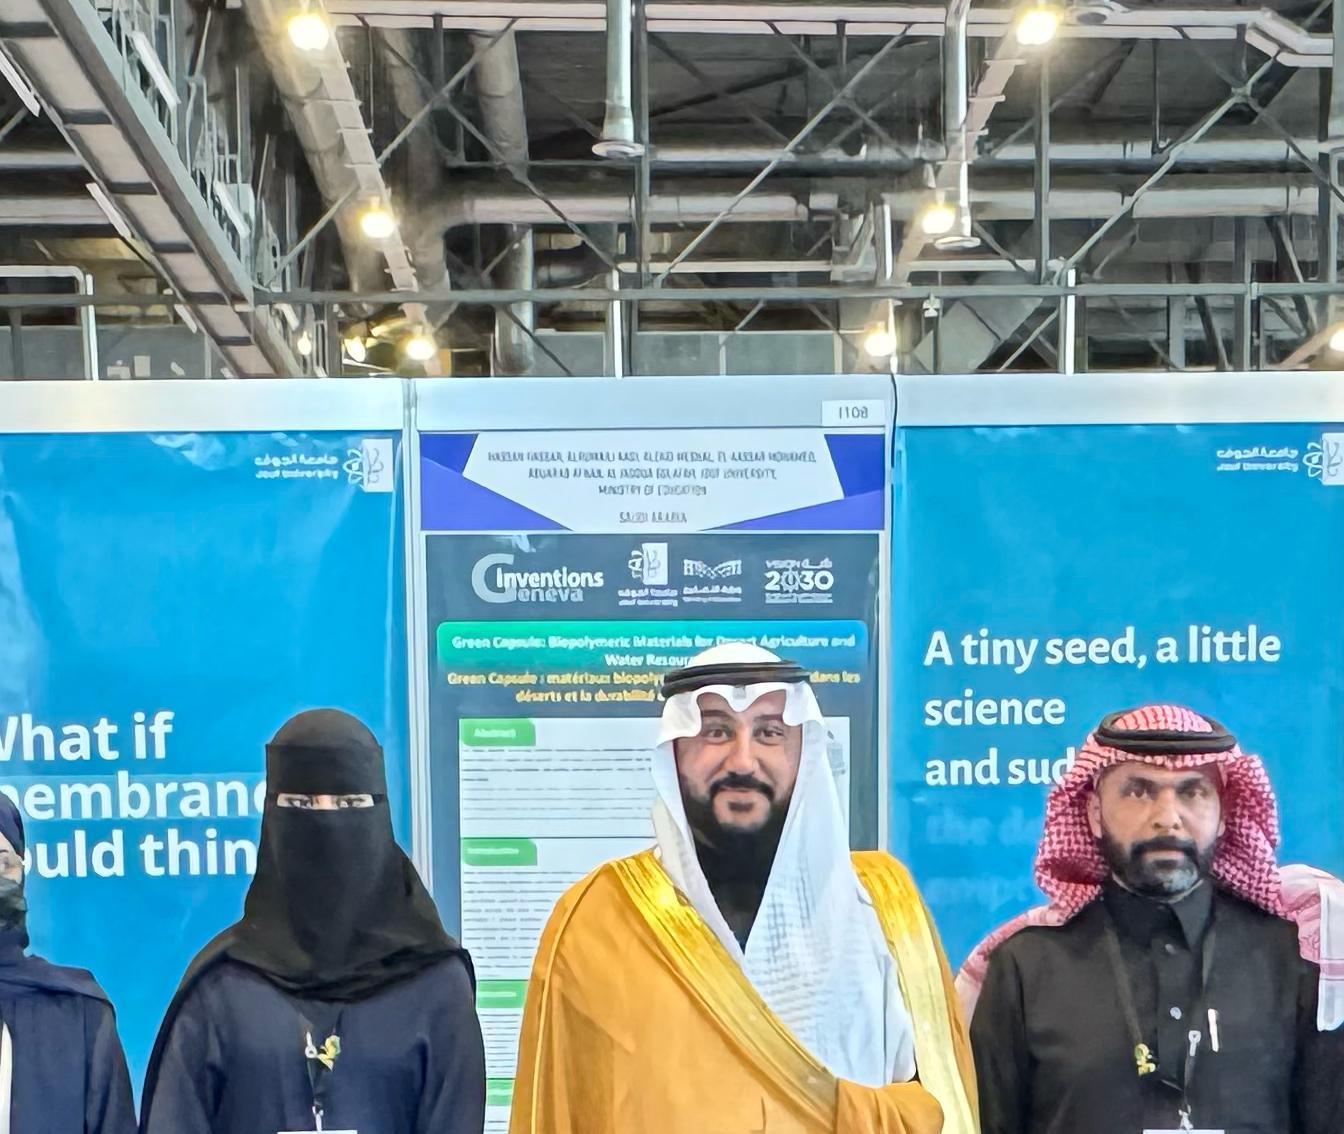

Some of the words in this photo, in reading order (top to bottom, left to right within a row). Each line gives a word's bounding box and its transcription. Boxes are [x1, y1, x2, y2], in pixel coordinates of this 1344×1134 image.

[764, 571, 834, 591] 2030
[452, 636, 491, 649] Green
[830, 634, 856, 647] and
[605, 653, 644, 666] Water
[924, 630, 954, 667] A
[961, 628, 1038, 675] tiny
[1045, 626, 1147, 669] seed,
[1156, 636, 1179, 663] a
[1189, 624, 1281, 663] little
[612, 671, 665, 686] biopoly
[924, 689, 1066, 727] science
[133, 711, 175, 760] if
[925, 747, 1000, 785] and
[1008, 747, 1075, 785] sud
[140, 828, 258, 876] thin
